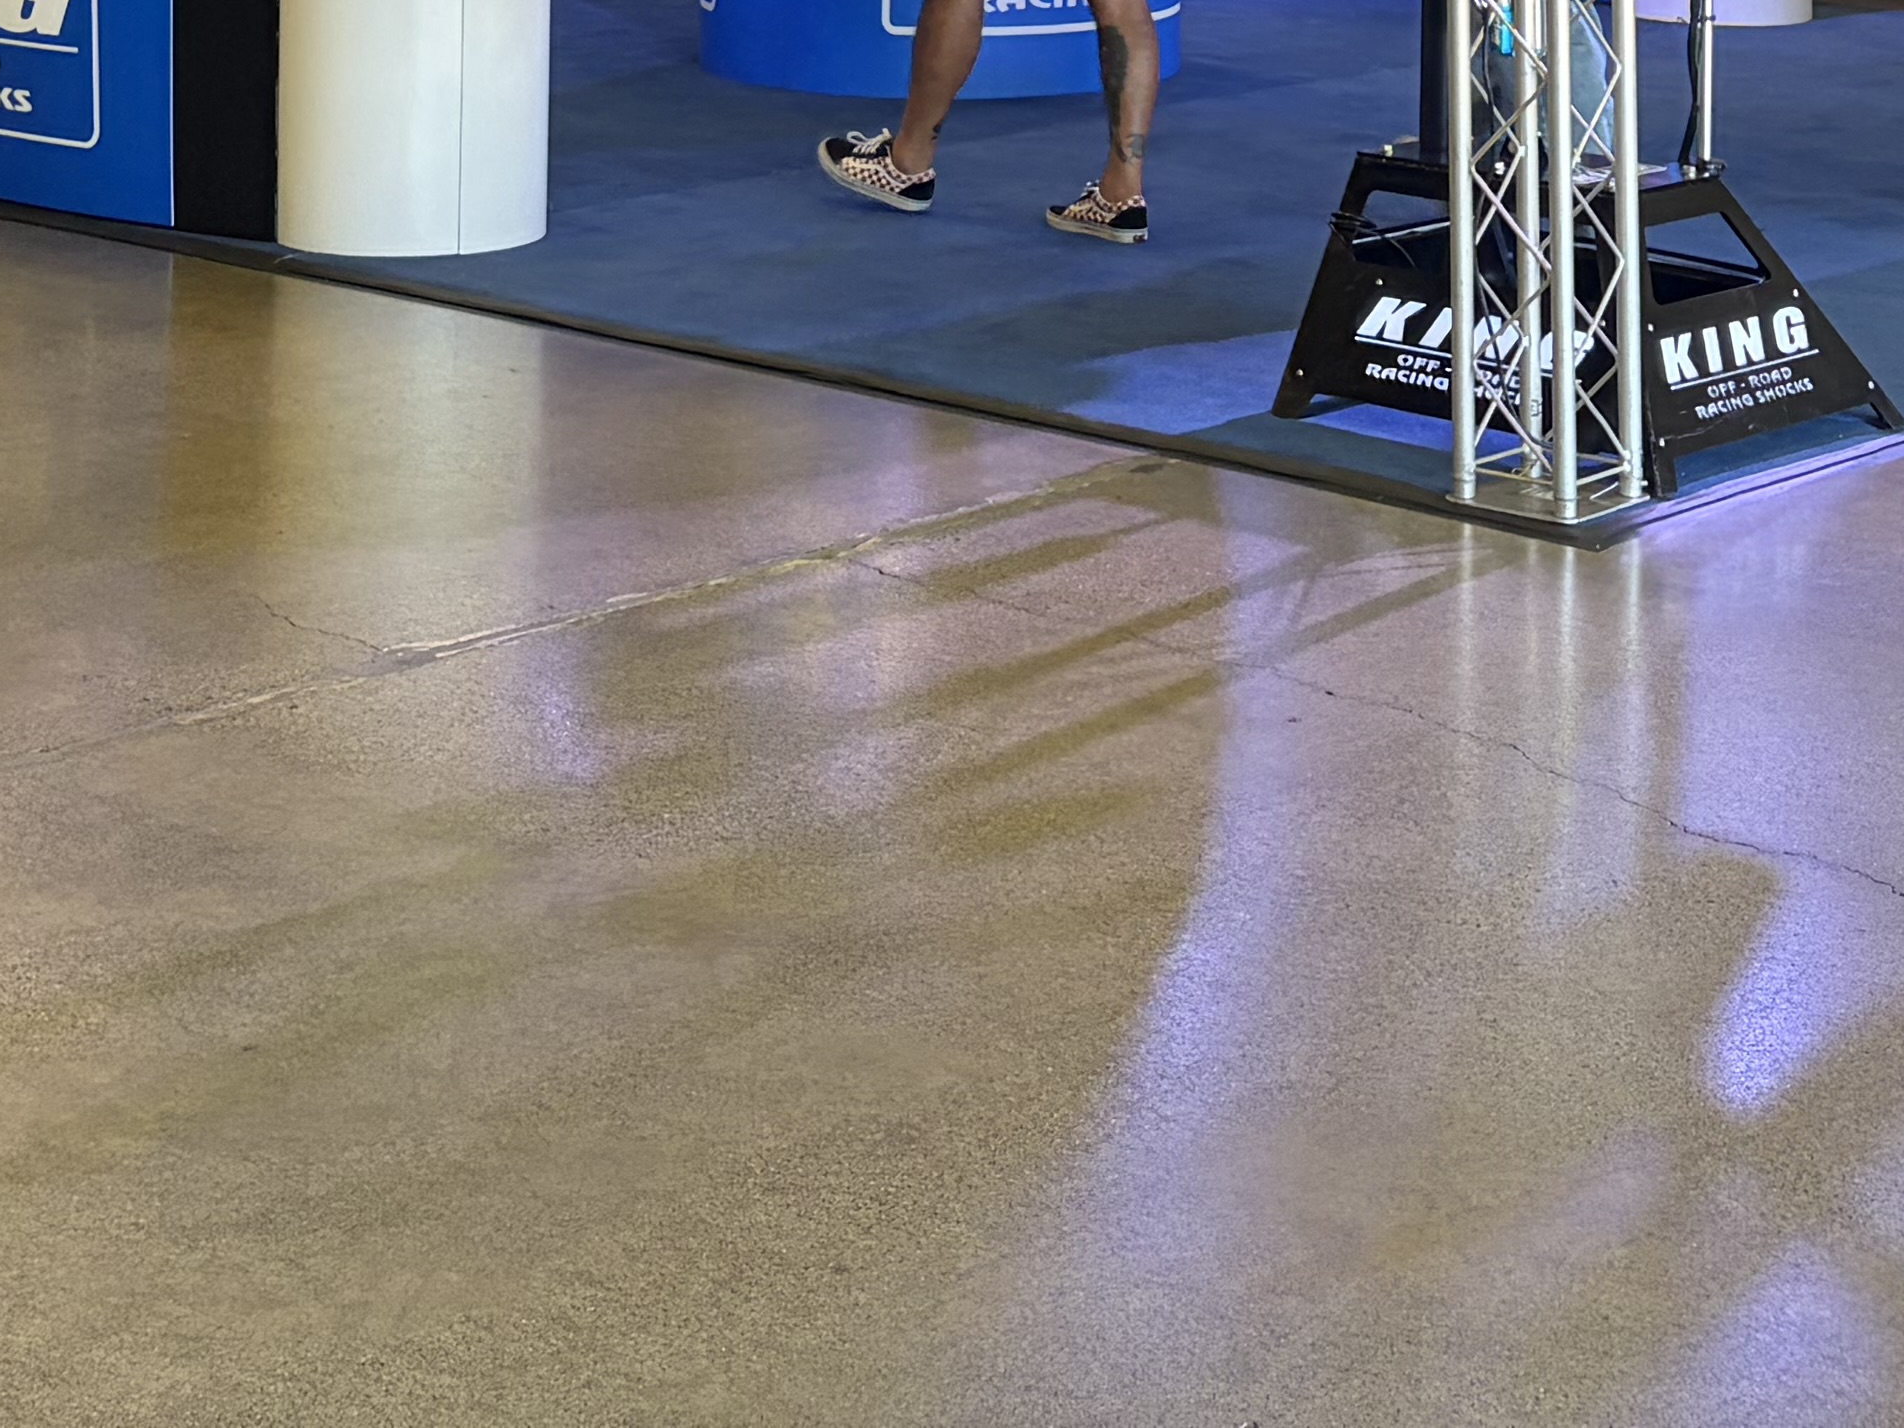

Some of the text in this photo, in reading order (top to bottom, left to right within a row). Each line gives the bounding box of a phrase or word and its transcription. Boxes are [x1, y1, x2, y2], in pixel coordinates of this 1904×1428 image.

[1660, 305, 1813, 385] KING
[1365, 362, 1450, 391] RACING
[1694, 377, 1814, 420] RACING SHOCKS
